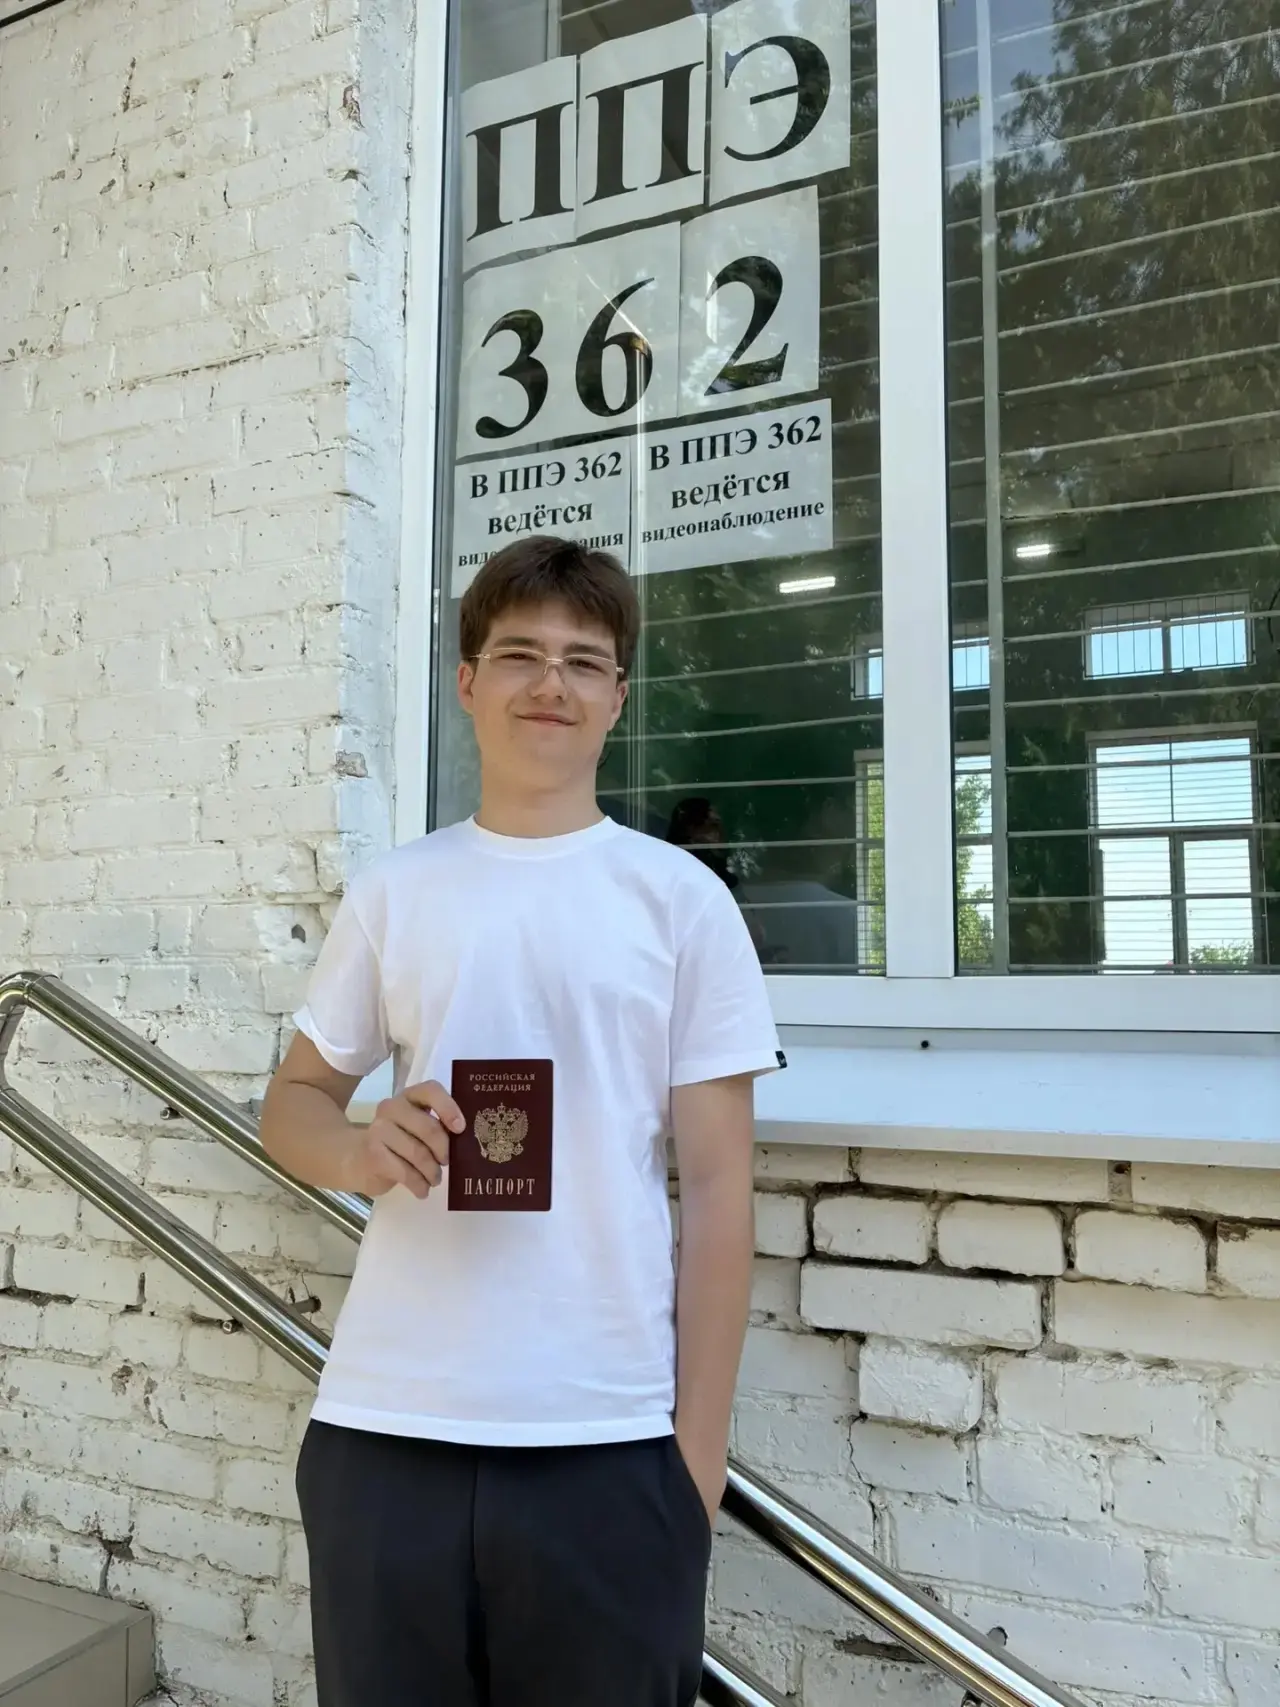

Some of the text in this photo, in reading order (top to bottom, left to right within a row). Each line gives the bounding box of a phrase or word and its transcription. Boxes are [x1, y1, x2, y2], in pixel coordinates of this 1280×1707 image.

[466, 35, 831, 242] ППЭ
[475, 255, 789, 439] 362
[648, 415, 823, 472] В ППЭ 362
[470, 451, 623, 499] В ППЭ 362
[671, 469, 790, 510] ведётся
[488, 502, 593, 536] ведётся
[641, 500, 825, 545] видеонаблюдение
[469, 1073, 535, 1081] РОССИЙСКАЯ
[473, 1083, 531, 1093] ФЕДЕРАЦИЯ
[464, 1178, 535, 1195] ПАСПОРТ
